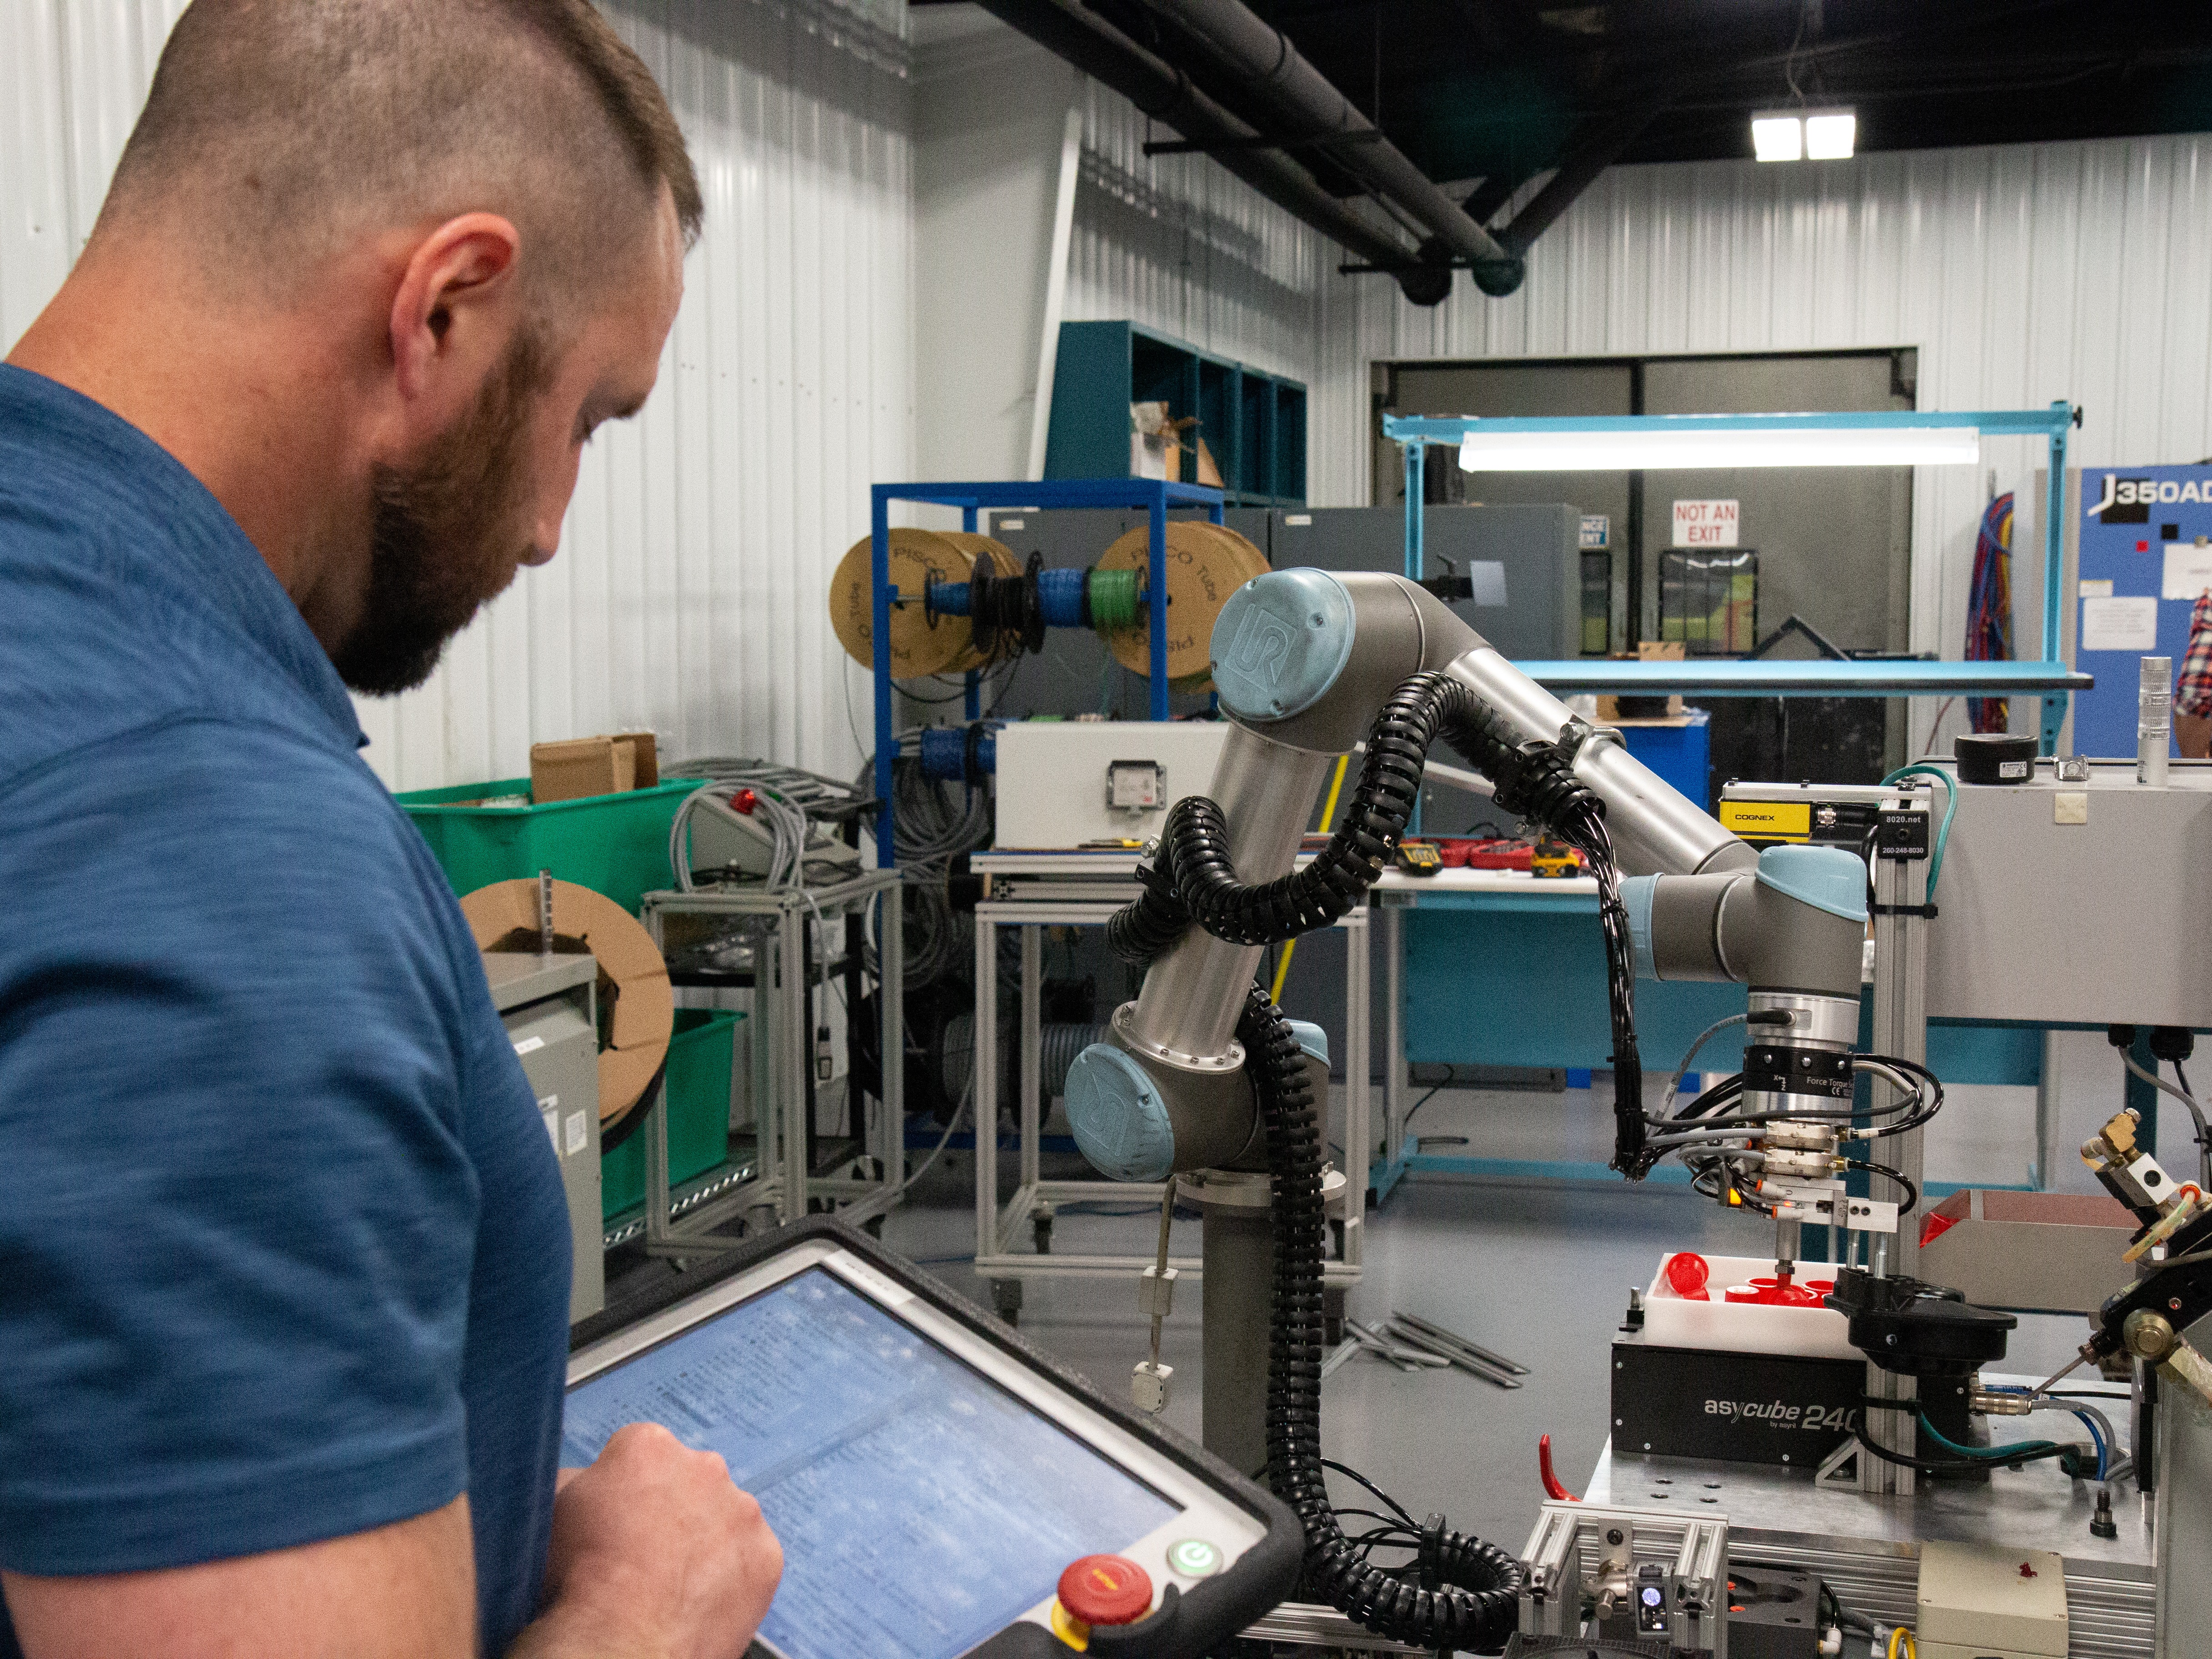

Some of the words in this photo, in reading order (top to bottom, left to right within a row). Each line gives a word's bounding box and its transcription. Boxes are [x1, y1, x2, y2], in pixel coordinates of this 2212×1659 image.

[1676, 504, 1708, 521] NOT
[1713, 504, 1735, 521] AN
[1688, 525, 1721, 543] EXIT
[1131, 546, 1193, 564] PICO
[1806, 1076, 1827, 1086] Force
[1829, 1079, 1848, 1089] Torque
[1704, 1399, 1800, 1424] asycube
